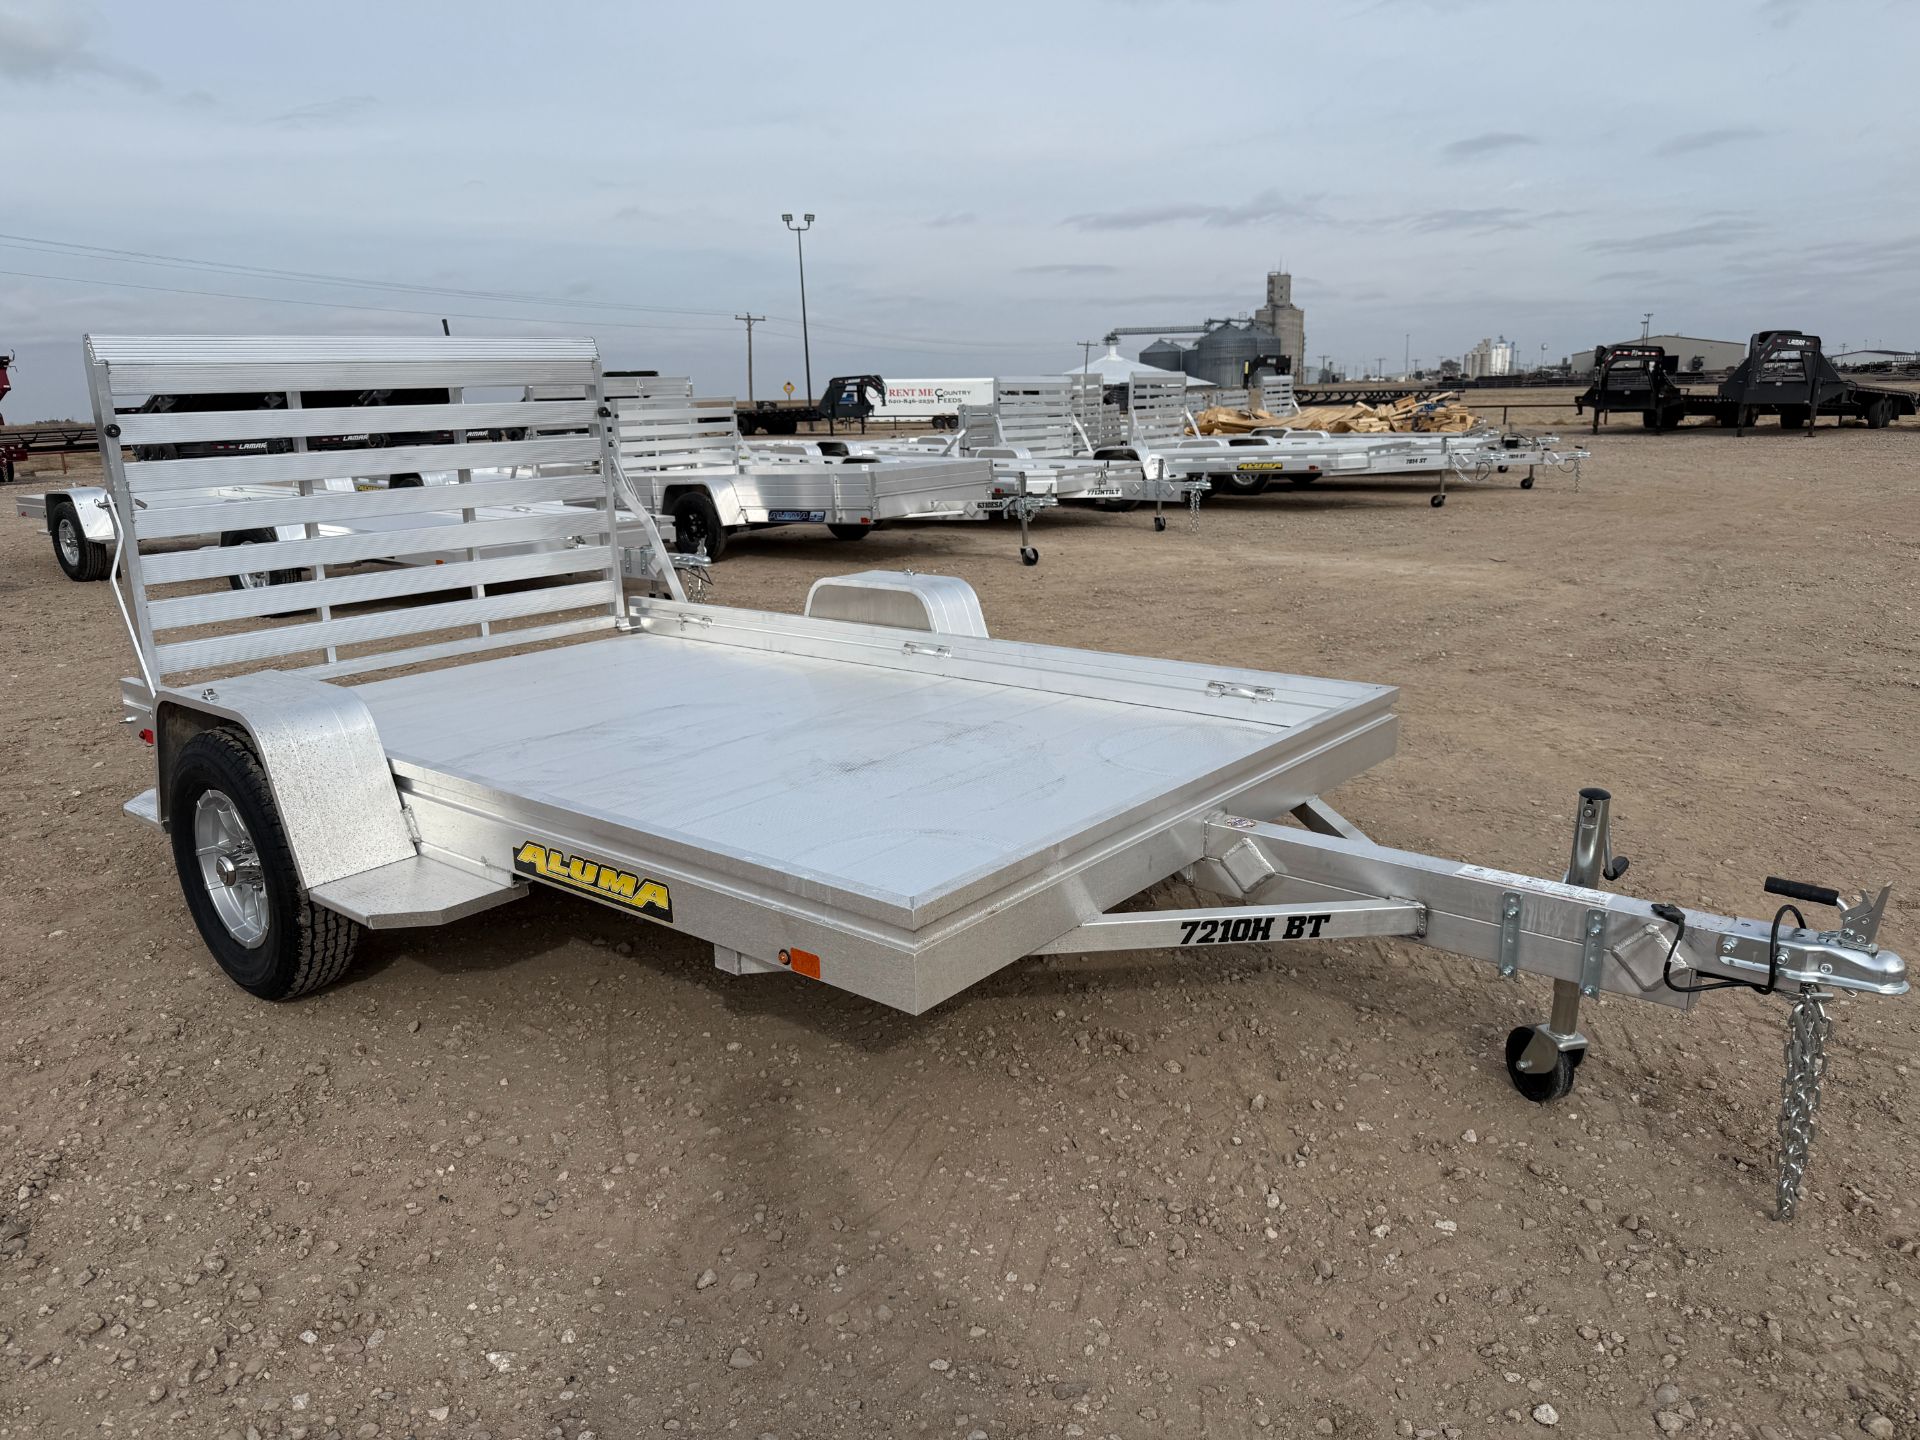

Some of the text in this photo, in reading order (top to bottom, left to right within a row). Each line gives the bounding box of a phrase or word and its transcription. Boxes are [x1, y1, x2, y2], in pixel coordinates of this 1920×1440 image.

[888, 388, 934, 397] RENT ME
[934, 388, 971, 397] COUNTRY
[937, 396, 962, 404] FEEDS
[516, 841, 670, 911] ALUMA
[1180, 914, 1331, 945] 7210H BT
